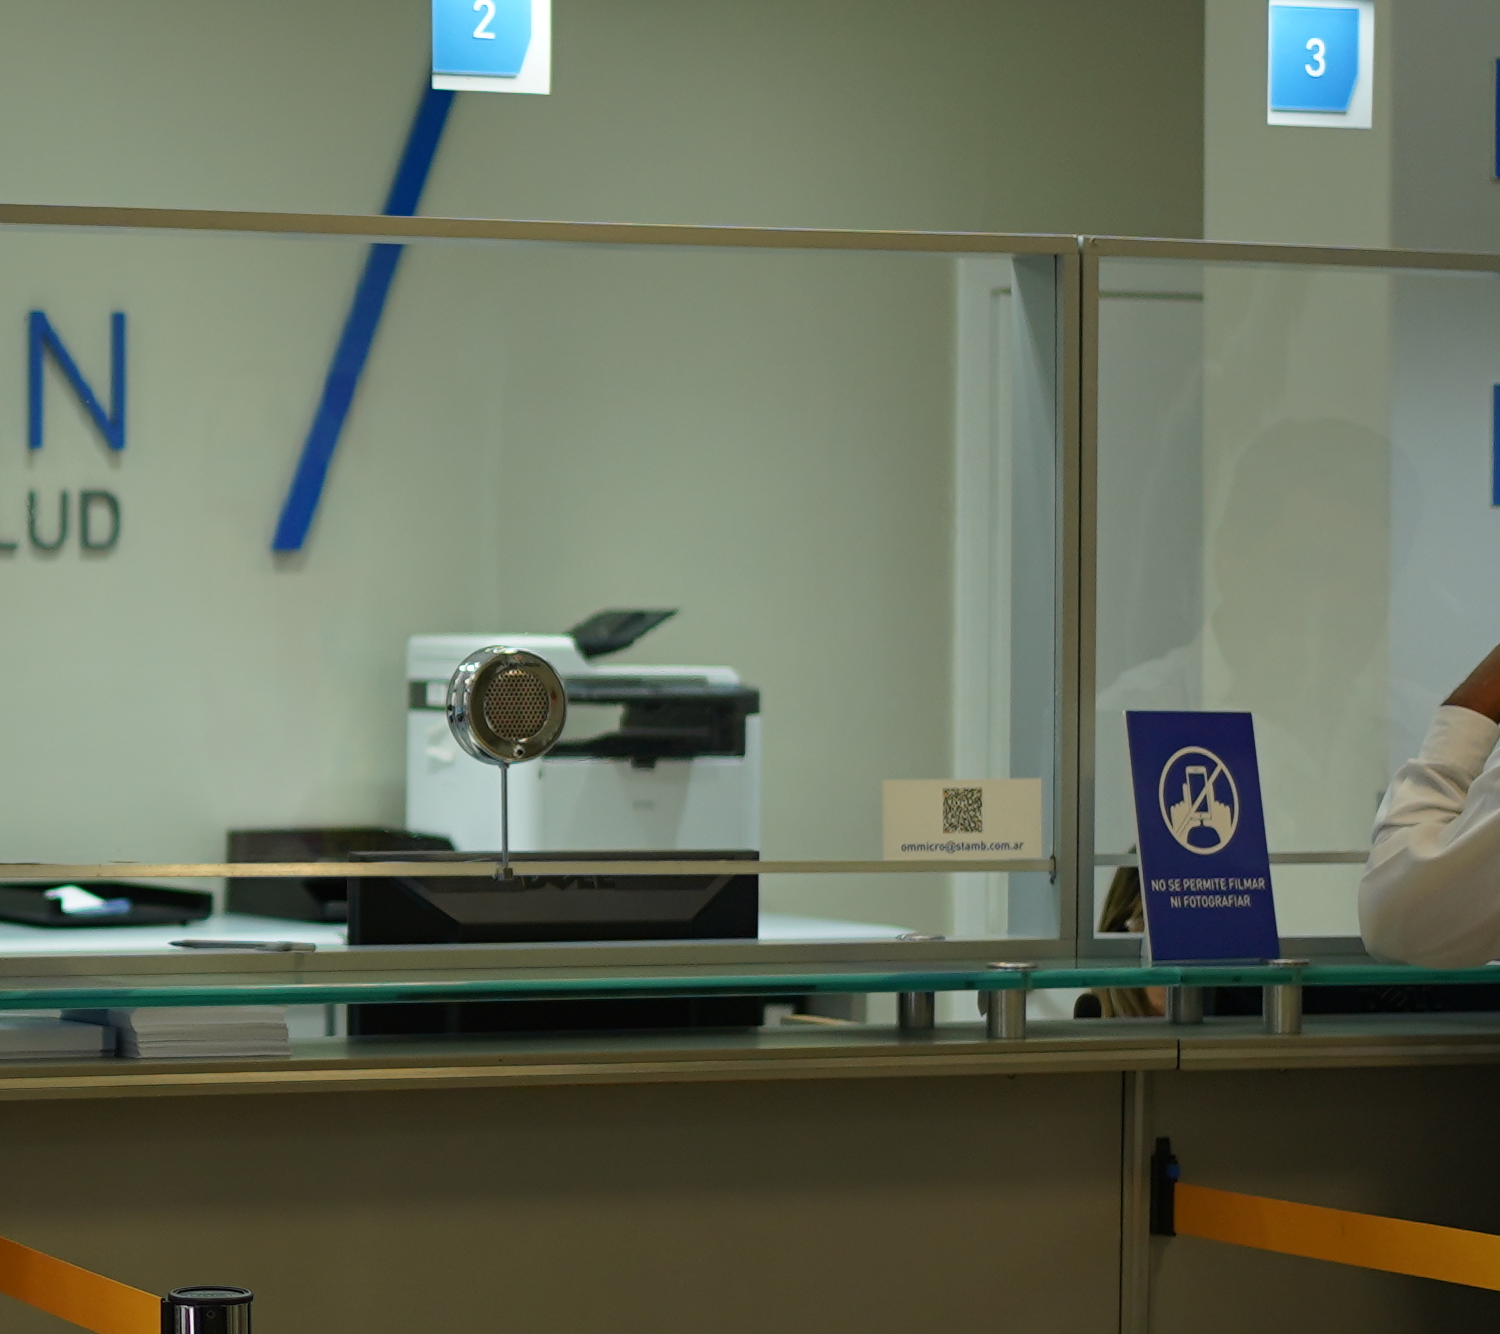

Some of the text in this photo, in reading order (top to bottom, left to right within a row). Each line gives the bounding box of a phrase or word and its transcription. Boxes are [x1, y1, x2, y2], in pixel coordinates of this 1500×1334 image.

[1305, 37, 1326, 77] 3
[901, 840, 1024, 853] ommicro@stamb.com.ar
[1151, 877, 1266, 891] NO SE PERMITE FILMAR
[1170, 895, 1252, 908] NI FOTOGRAFIAR
